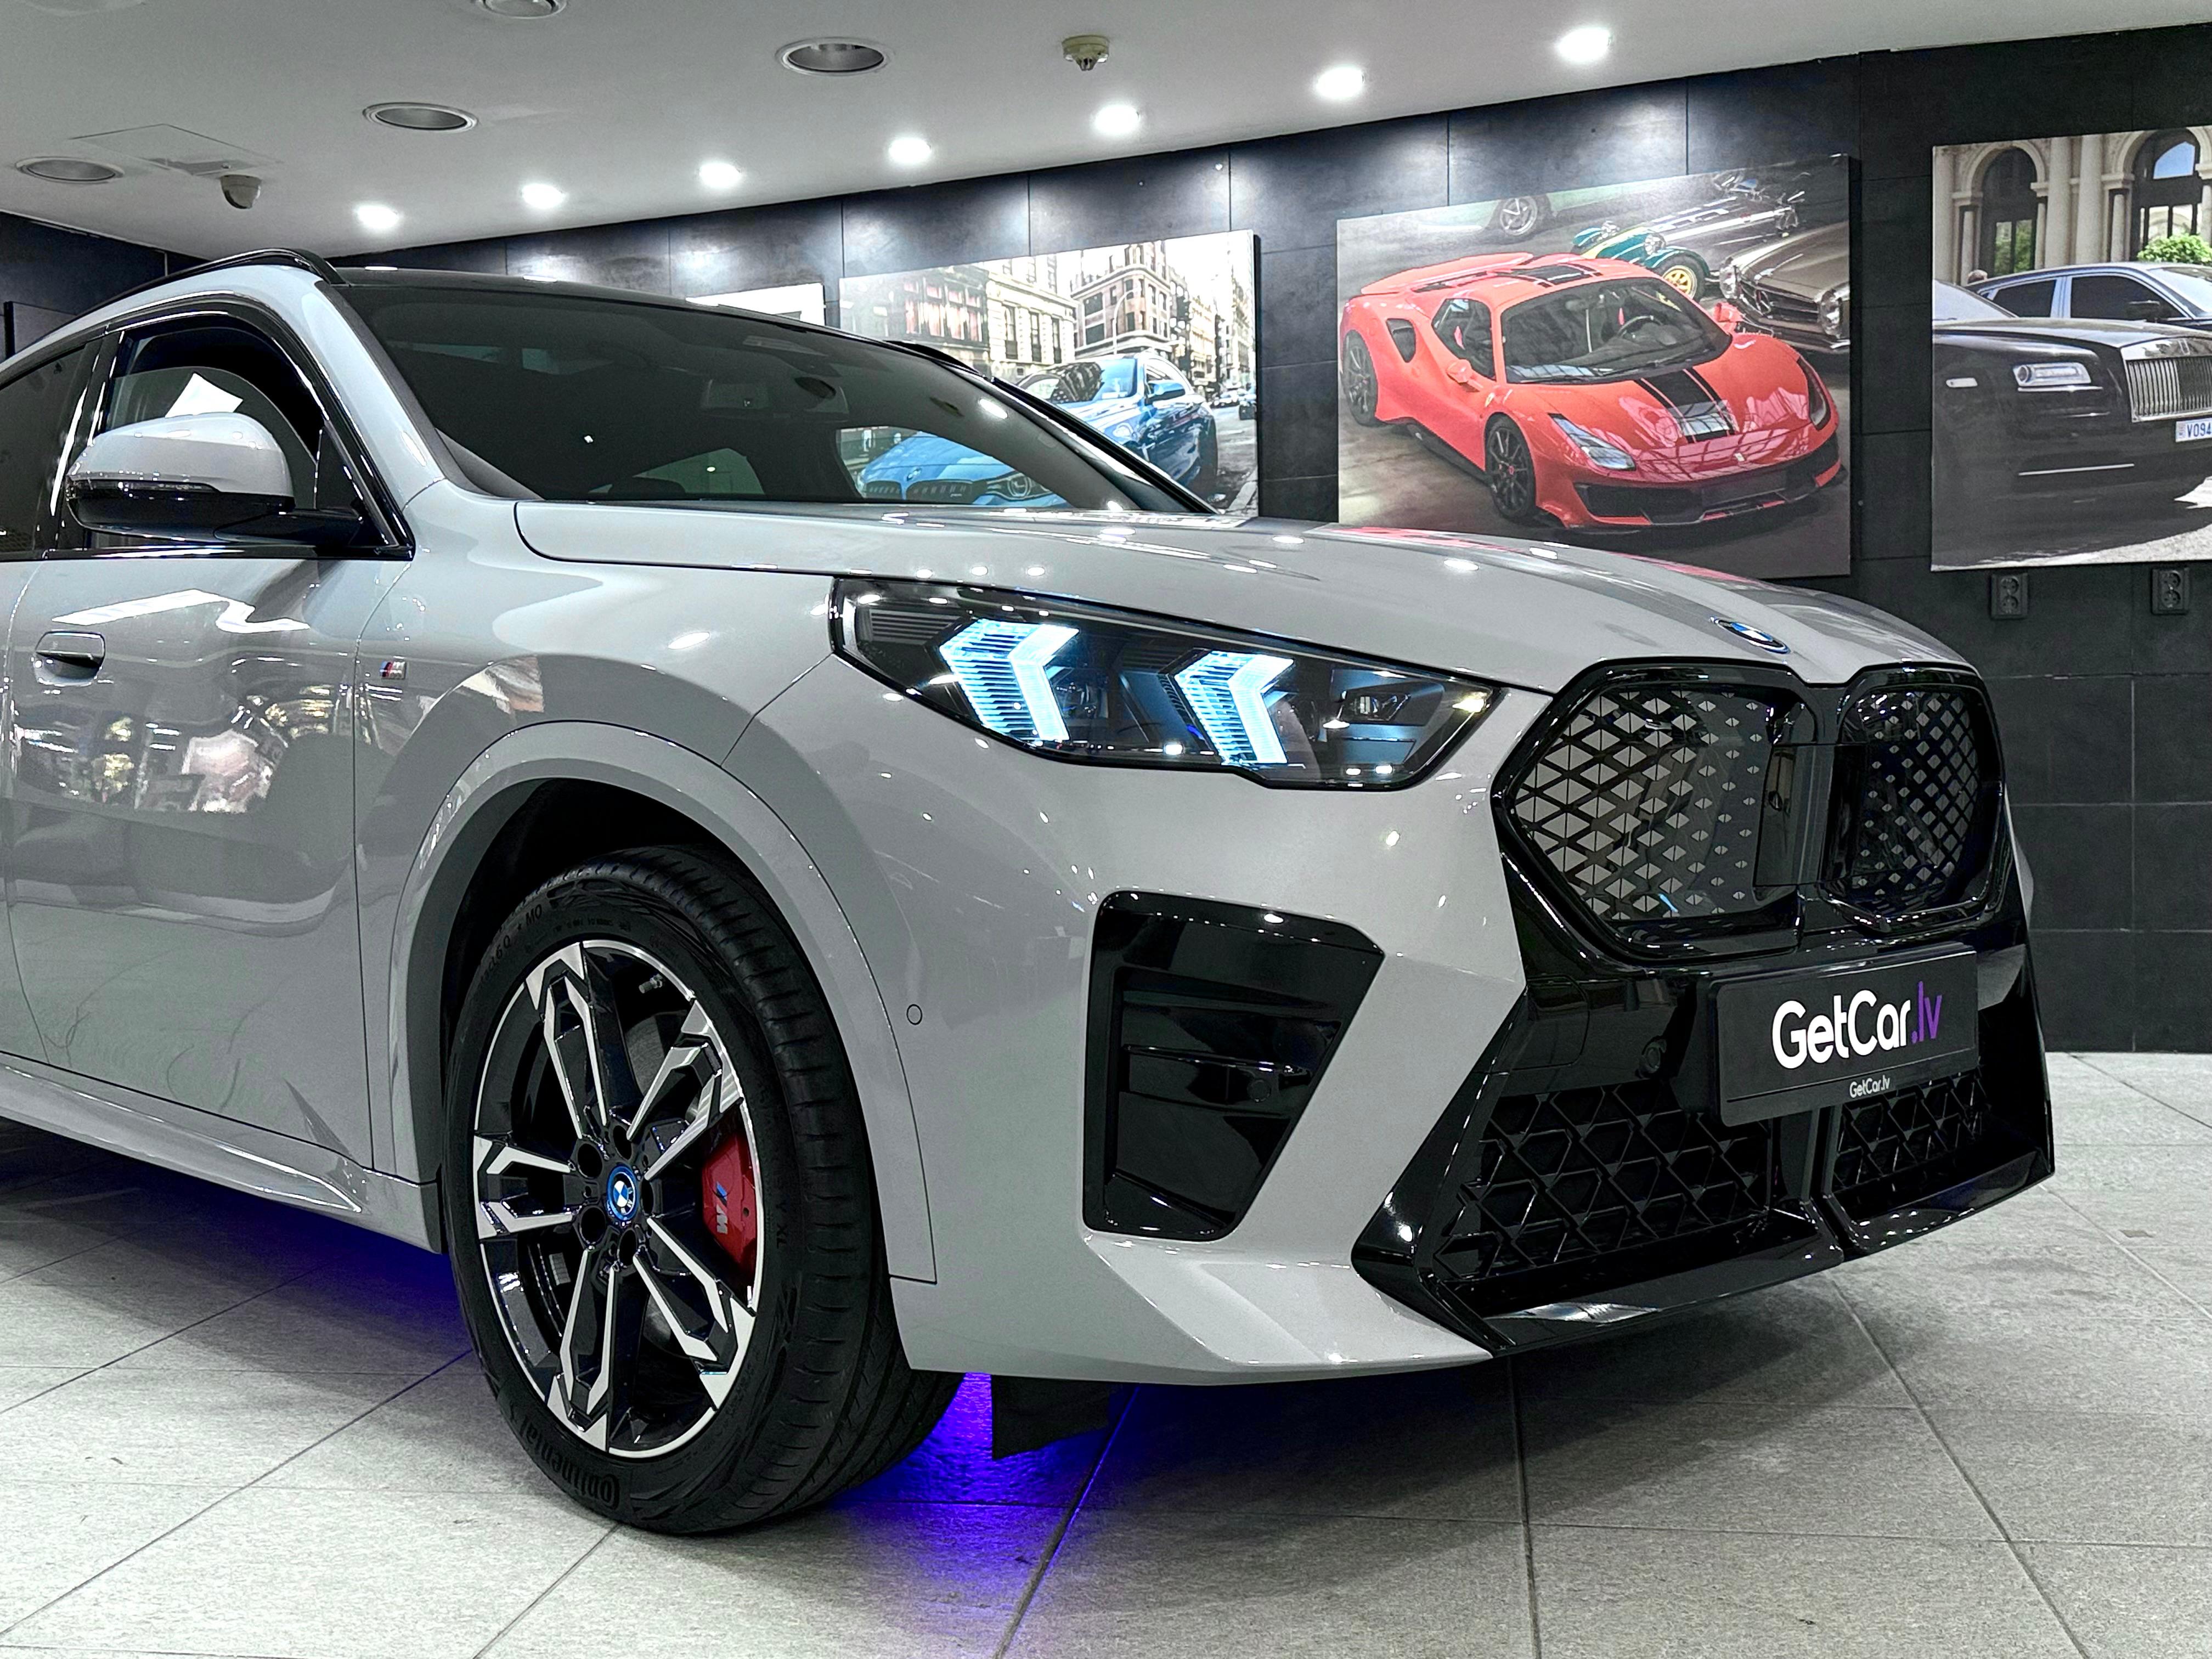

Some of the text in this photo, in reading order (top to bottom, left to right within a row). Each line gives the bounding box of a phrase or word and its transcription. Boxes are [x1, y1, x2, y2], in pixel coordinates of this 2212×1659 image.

[1771, 980, 1943, 1070] GetCar.lv
[1849, 1074, 1891, 1099] GetCar.lv
[518, 1415, 620, 1511] Continental
